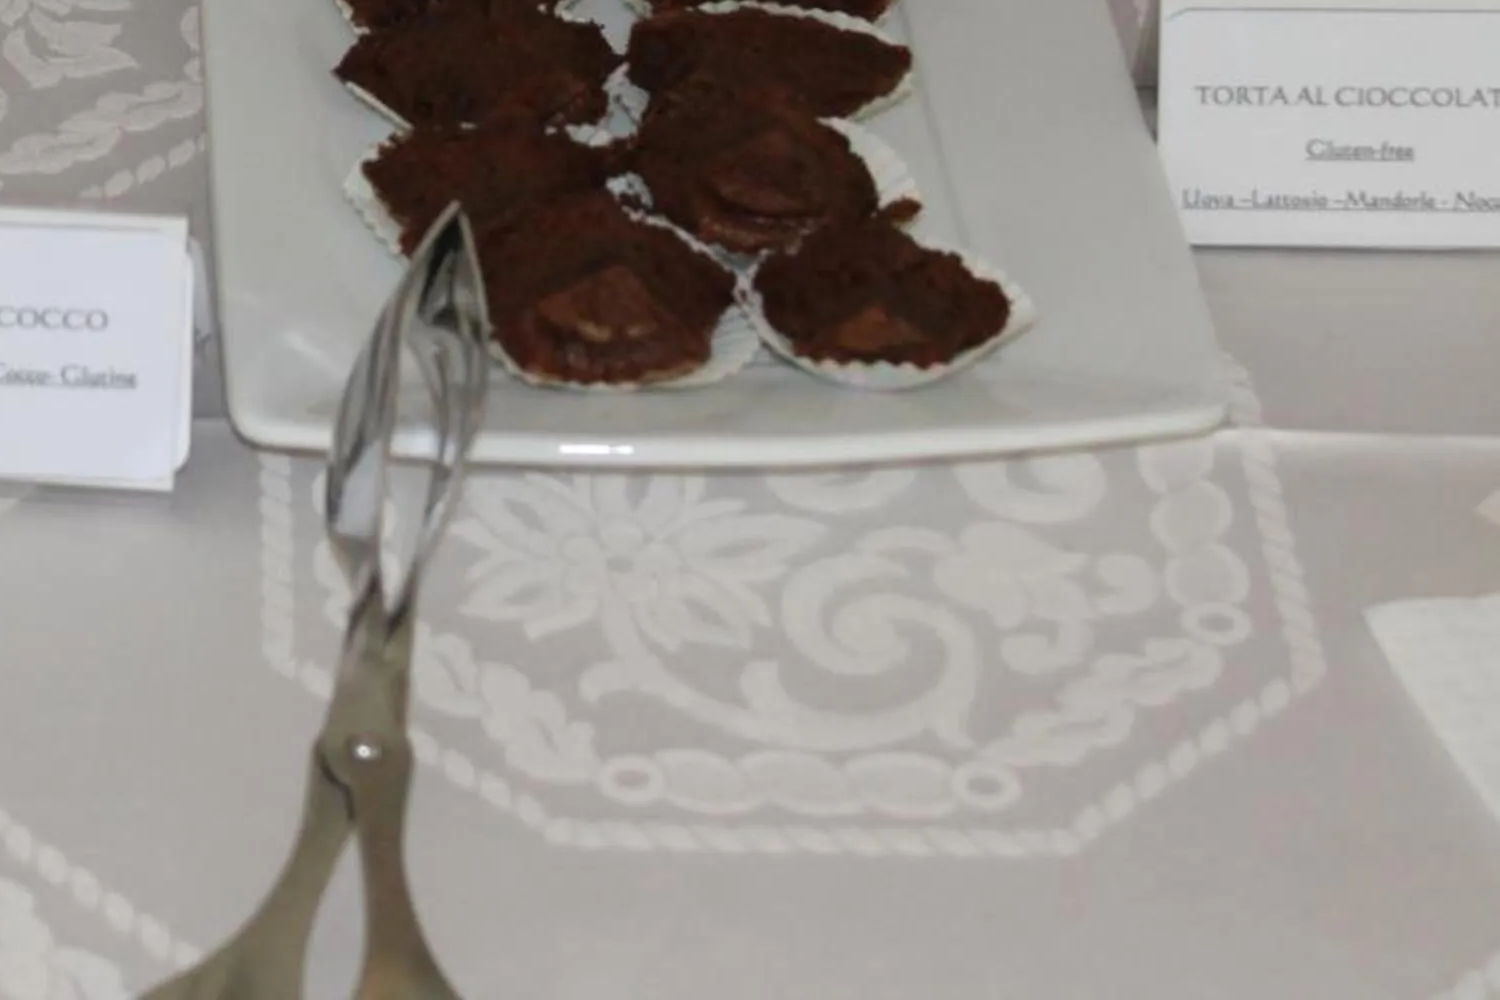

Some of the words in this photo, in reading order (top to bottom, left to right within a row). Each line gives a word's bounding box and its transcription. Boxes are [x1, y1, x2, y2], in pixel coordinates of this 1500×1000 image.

[1194, 85, 1287, 107] TORTA
[1298, 85, 1329, 107] AL
[1333, 86, 1500, 108] CIOCCOLAT
